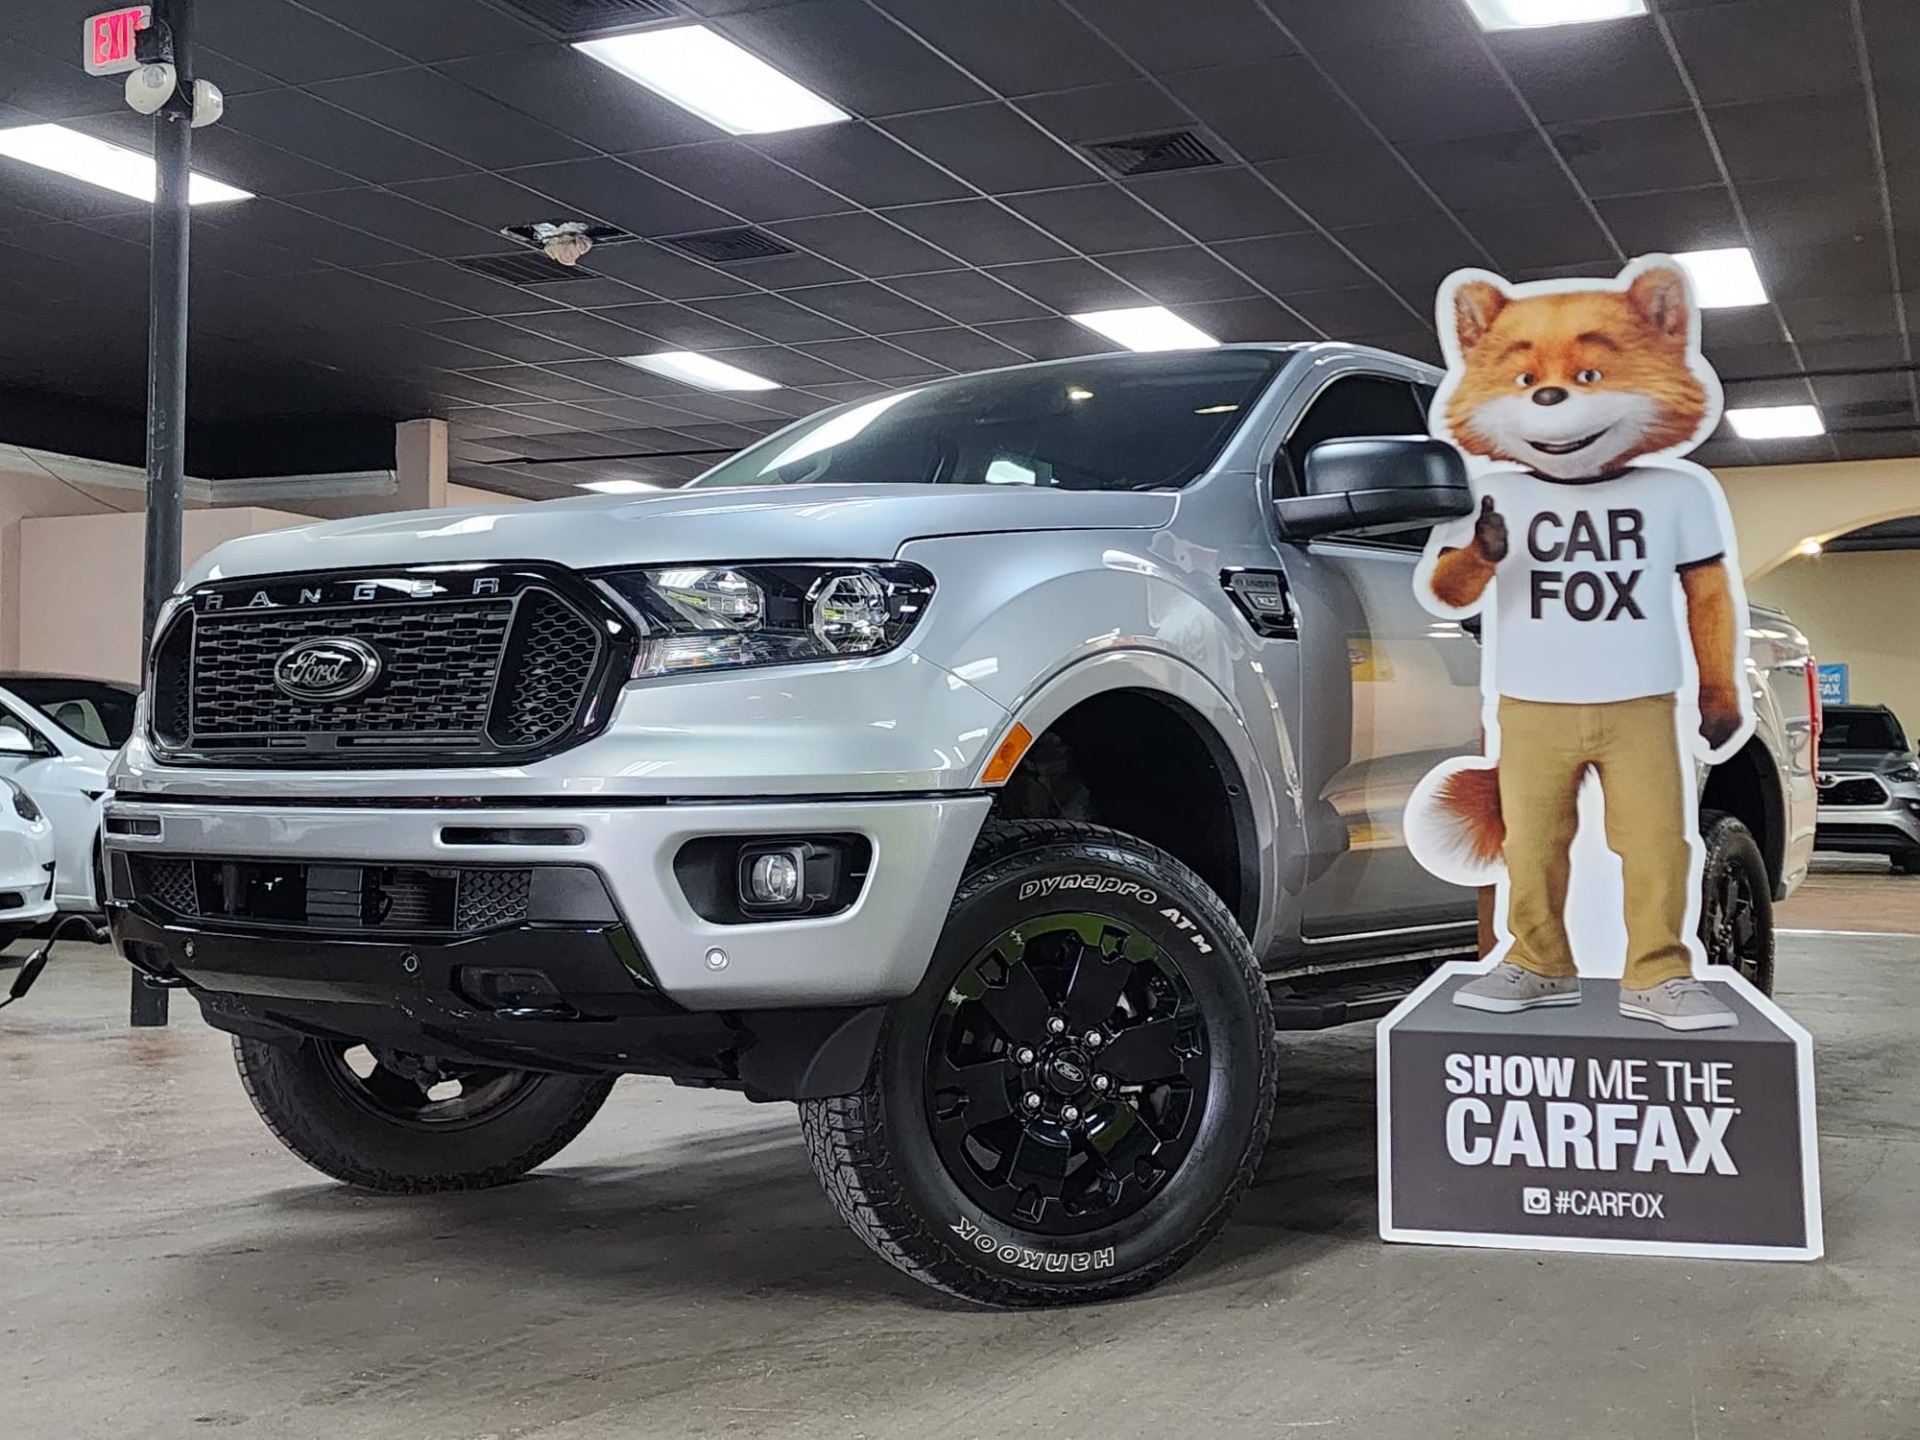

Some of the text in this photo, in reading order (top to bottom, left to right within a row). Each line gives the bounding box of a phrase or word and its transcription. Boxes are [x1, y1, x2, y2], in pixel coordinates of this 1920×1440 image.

[1527, 508, 1646, 562] CAR
[204, 577, 500, 611] RANGER
[1530, 569, 1646, 621] FOX
[287, 651, 352, 686] Ford
[1018, 873, 1157, 905] Dynapro
[1444, 1053, 1735, 1103] SHOW ME THE
[1445, 1097, 1740, 1176] CARFAX
[1554, 1189, 1665, 1219] #CARFOX
